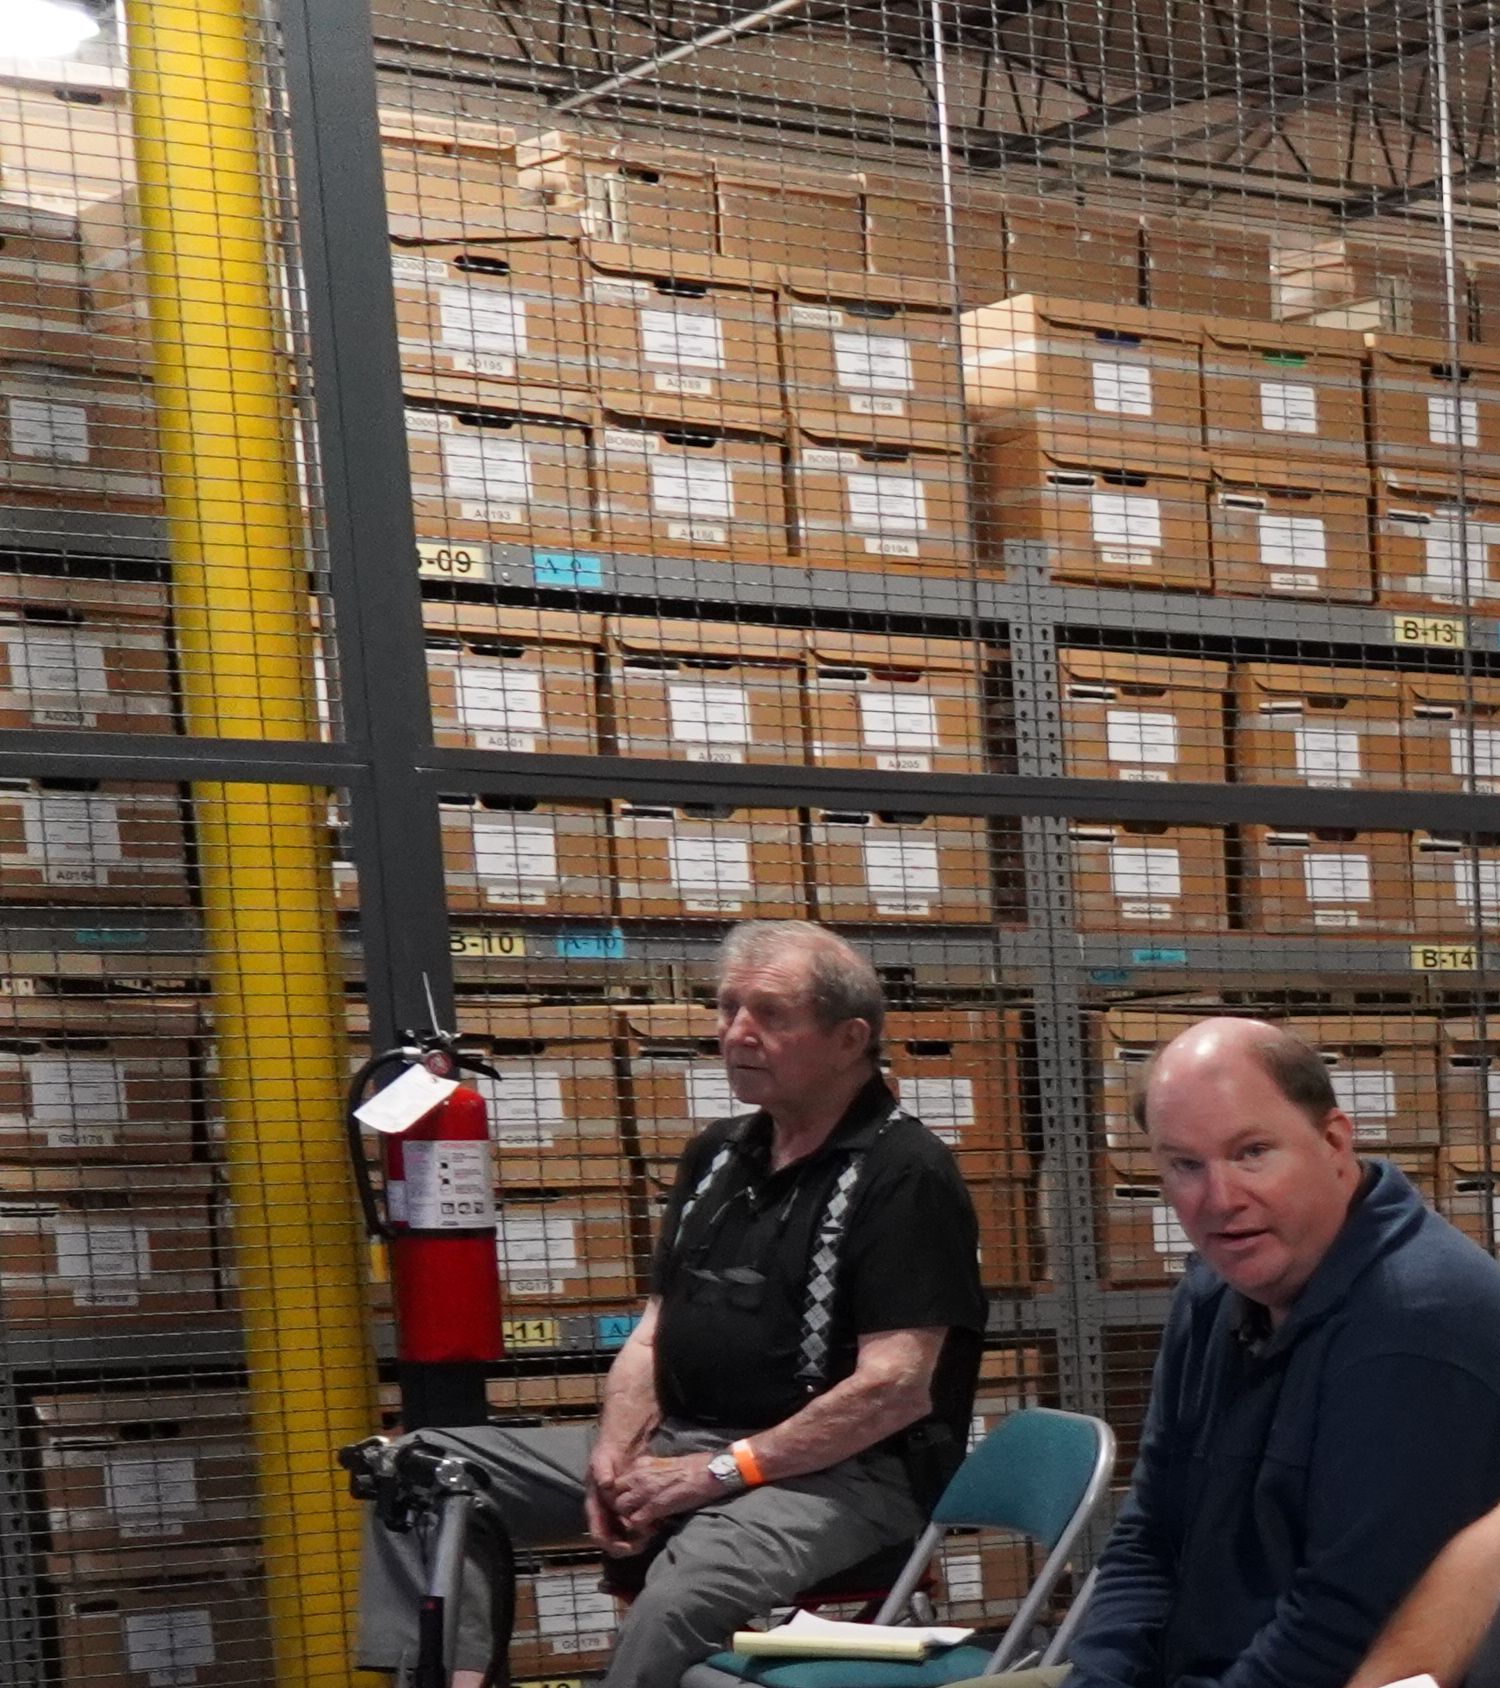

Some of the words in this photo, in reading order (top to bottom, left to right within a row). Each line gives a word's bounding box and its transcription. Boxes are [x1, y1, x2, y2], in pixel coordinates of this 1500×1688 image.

[1404, 620, 1454, 642] B-13
[1422, 947, 1473, 968] B-14
[504, 1321, 547, 1341] -11
